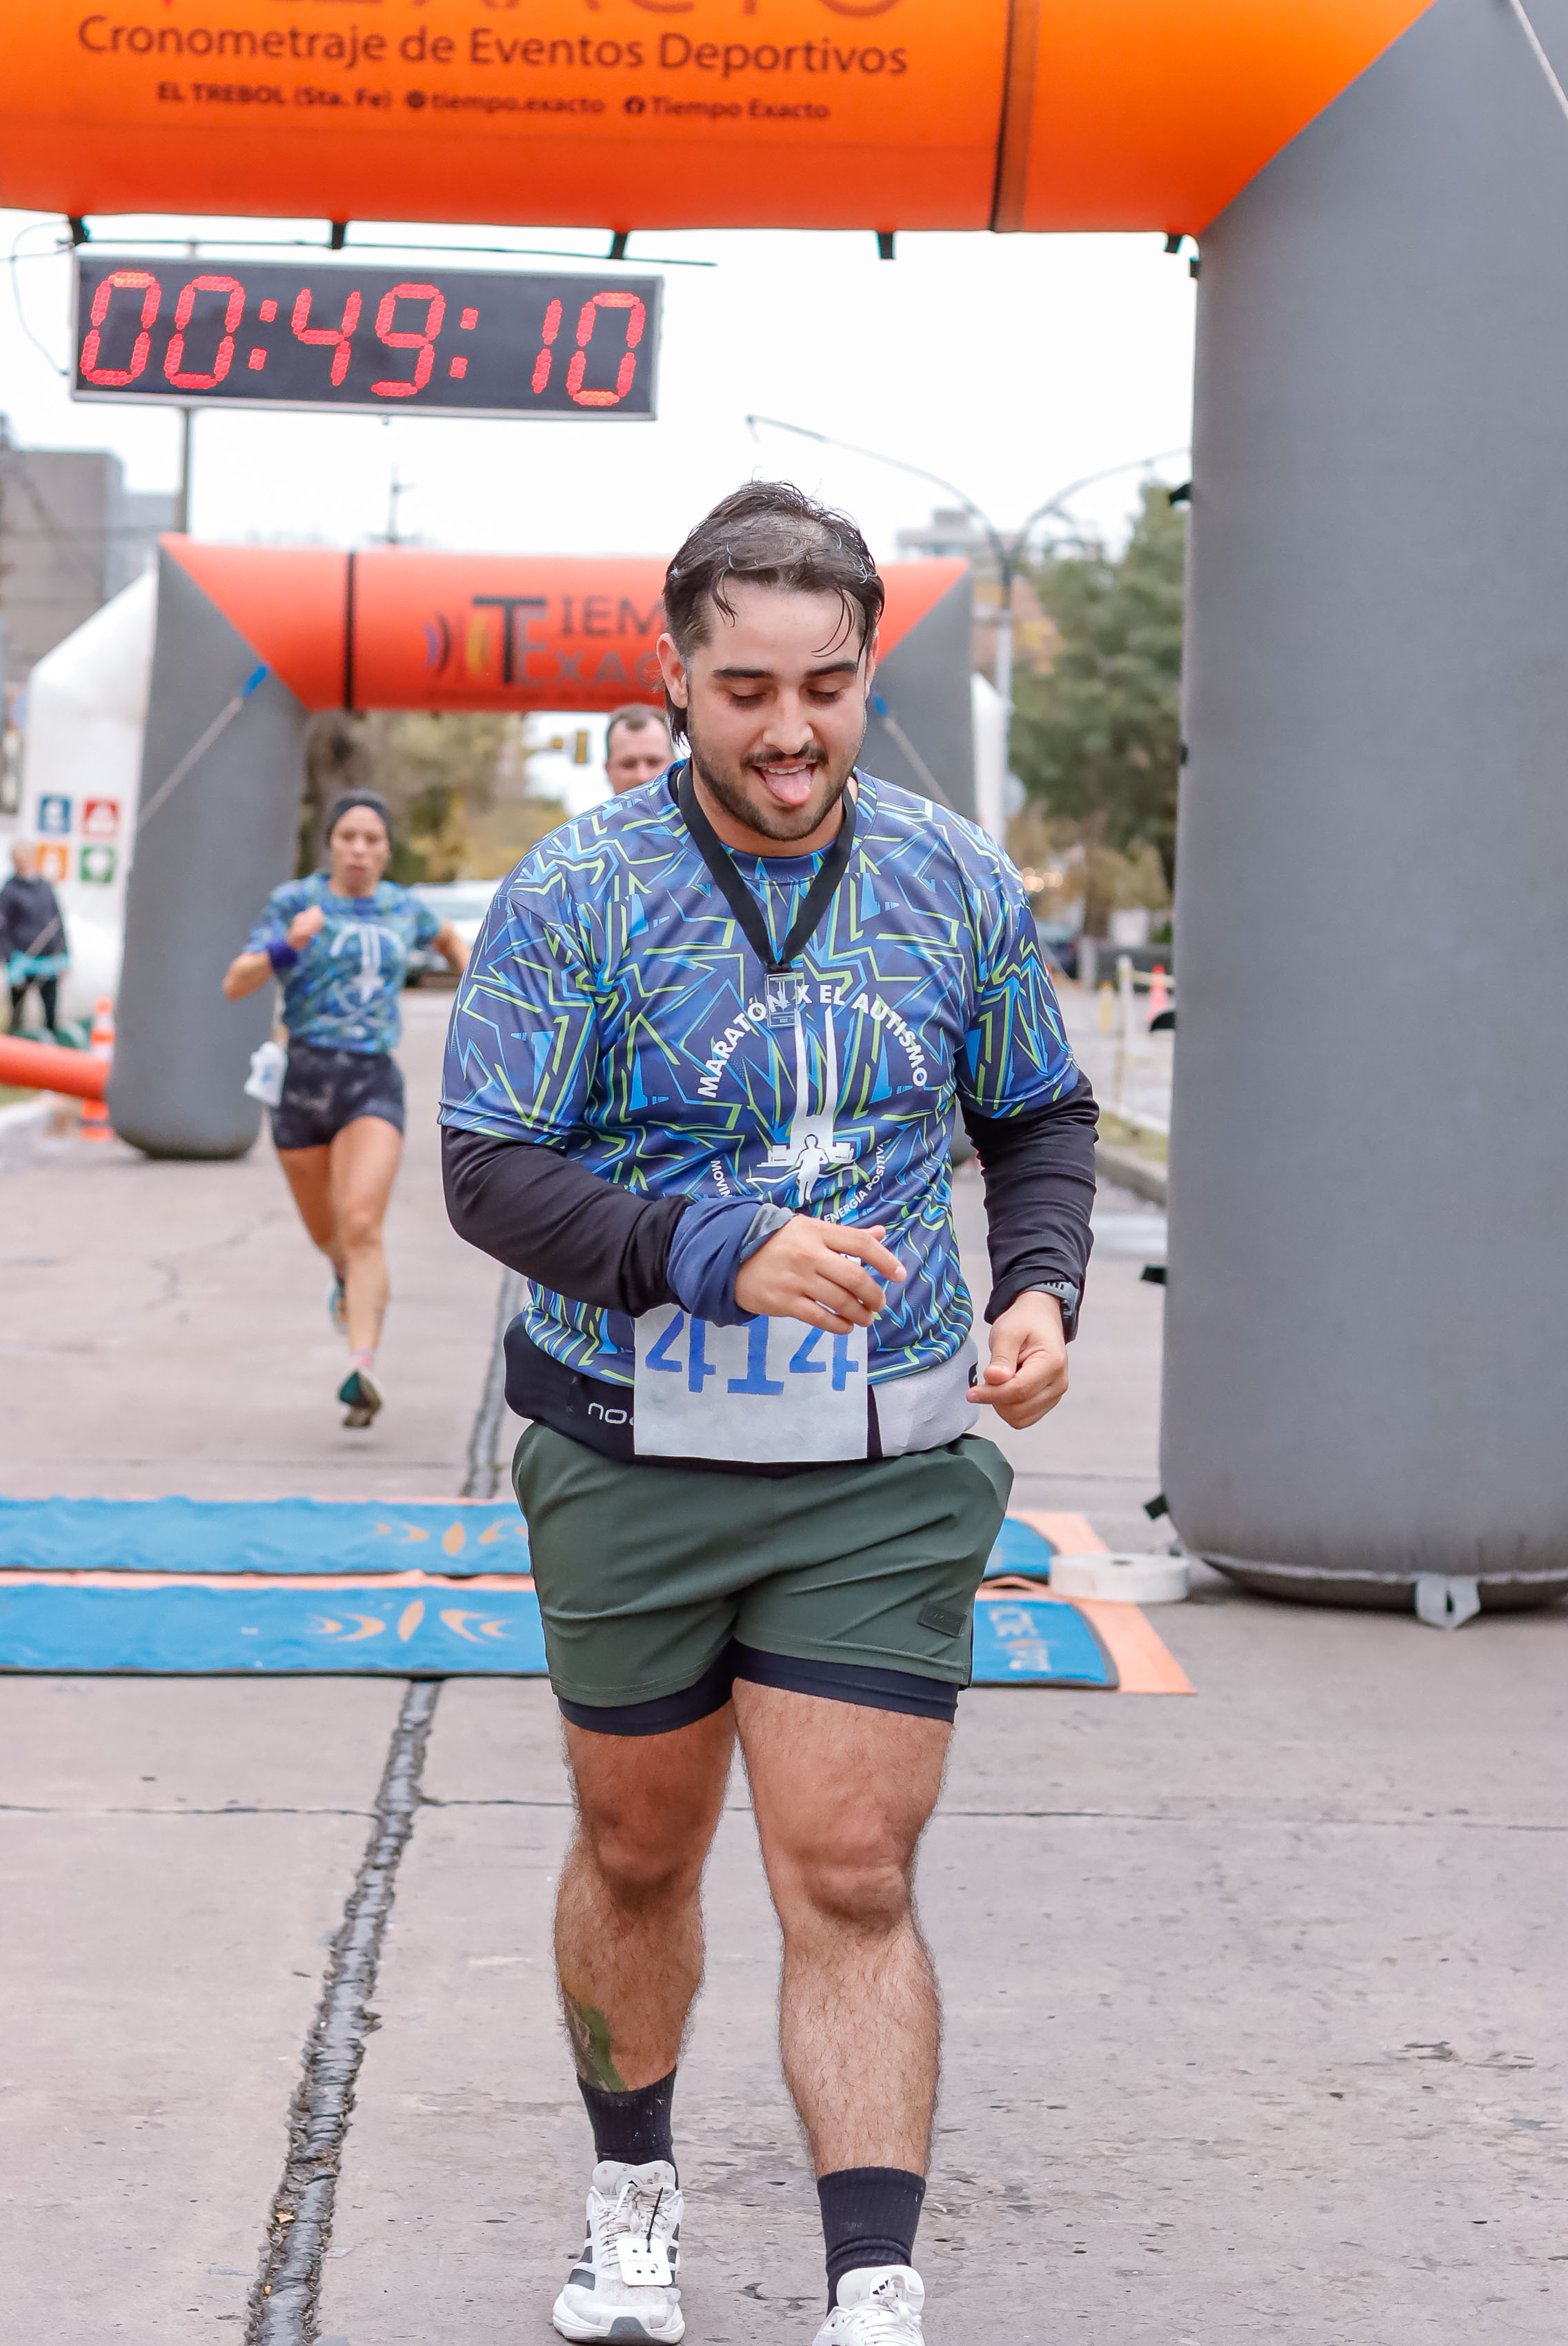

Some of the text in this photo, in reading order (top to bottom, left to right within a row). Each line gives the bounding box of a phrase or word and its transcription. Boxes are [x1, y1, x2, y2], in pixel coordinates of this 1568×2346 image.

[78, 14, 909, 79] Cronometraje de Eventos Deportivos
[157, 81, 185, 102] EL
[652, 95, 743, 119] Tiempo
[748, 98, 831, 121] Exacto
[795, 984, 813, 1004] X
[820, 984, 845, 1006] EL
[851, 992, 928, 1087] AUTISMO
[824, 1190, 869, 1224] ENERGÍA
[645, 1309, 859, 1395] 414
